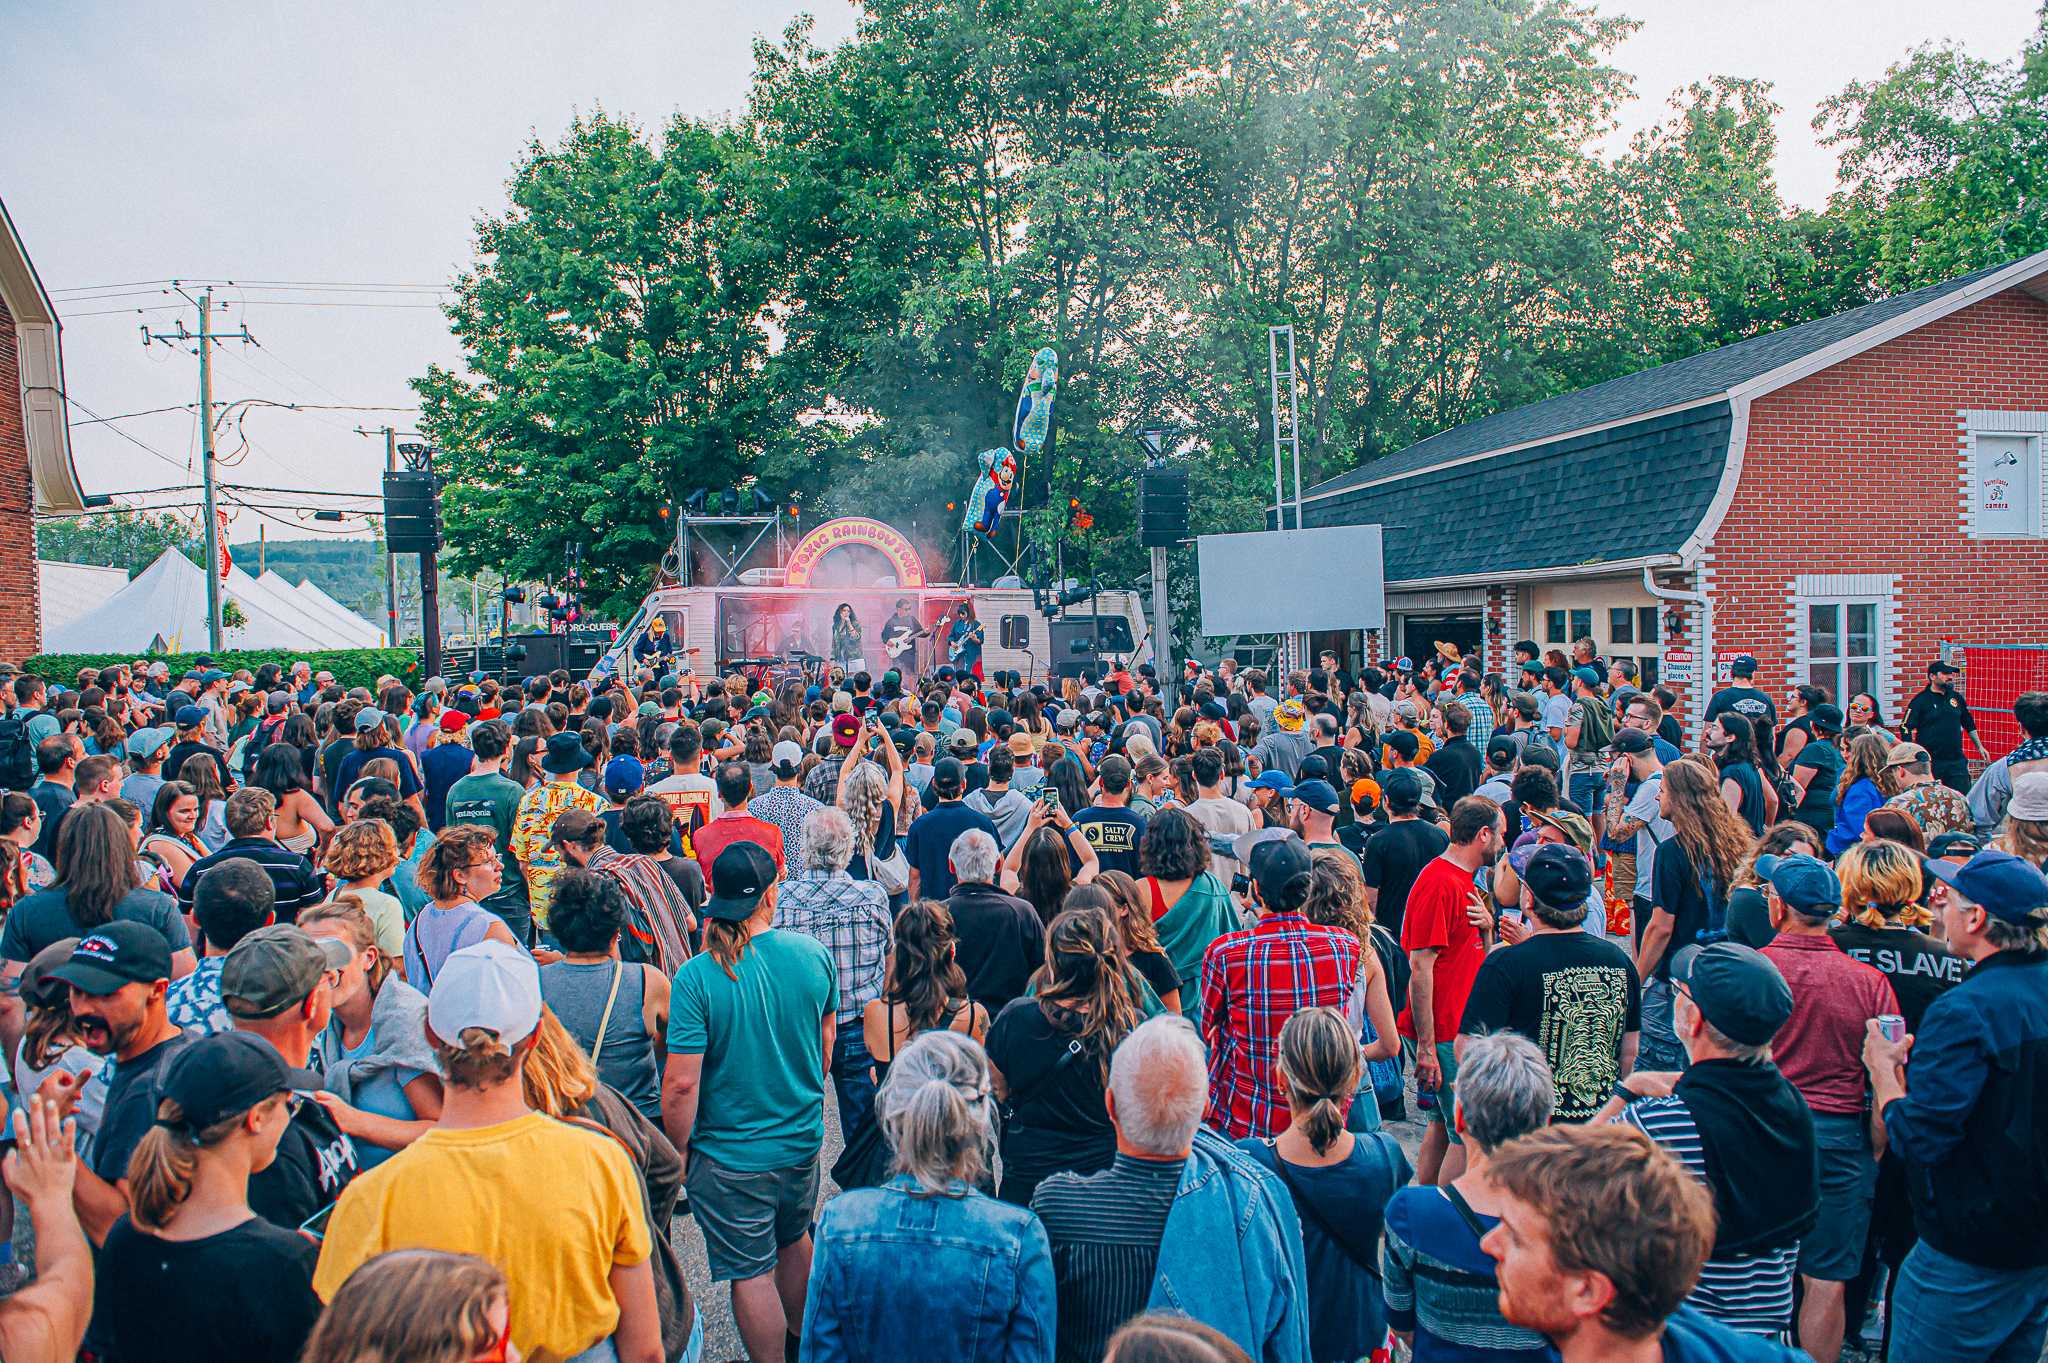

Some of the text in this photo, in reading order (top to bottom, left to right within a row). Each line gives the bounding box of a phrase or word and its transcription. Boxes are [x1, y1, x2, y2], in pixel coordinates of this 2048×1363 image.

[831, 525, 897, 546] RAINBOW
[1104, 826, 1127, 835] SALTY
[1105, 834, 1125, 843] CREW
